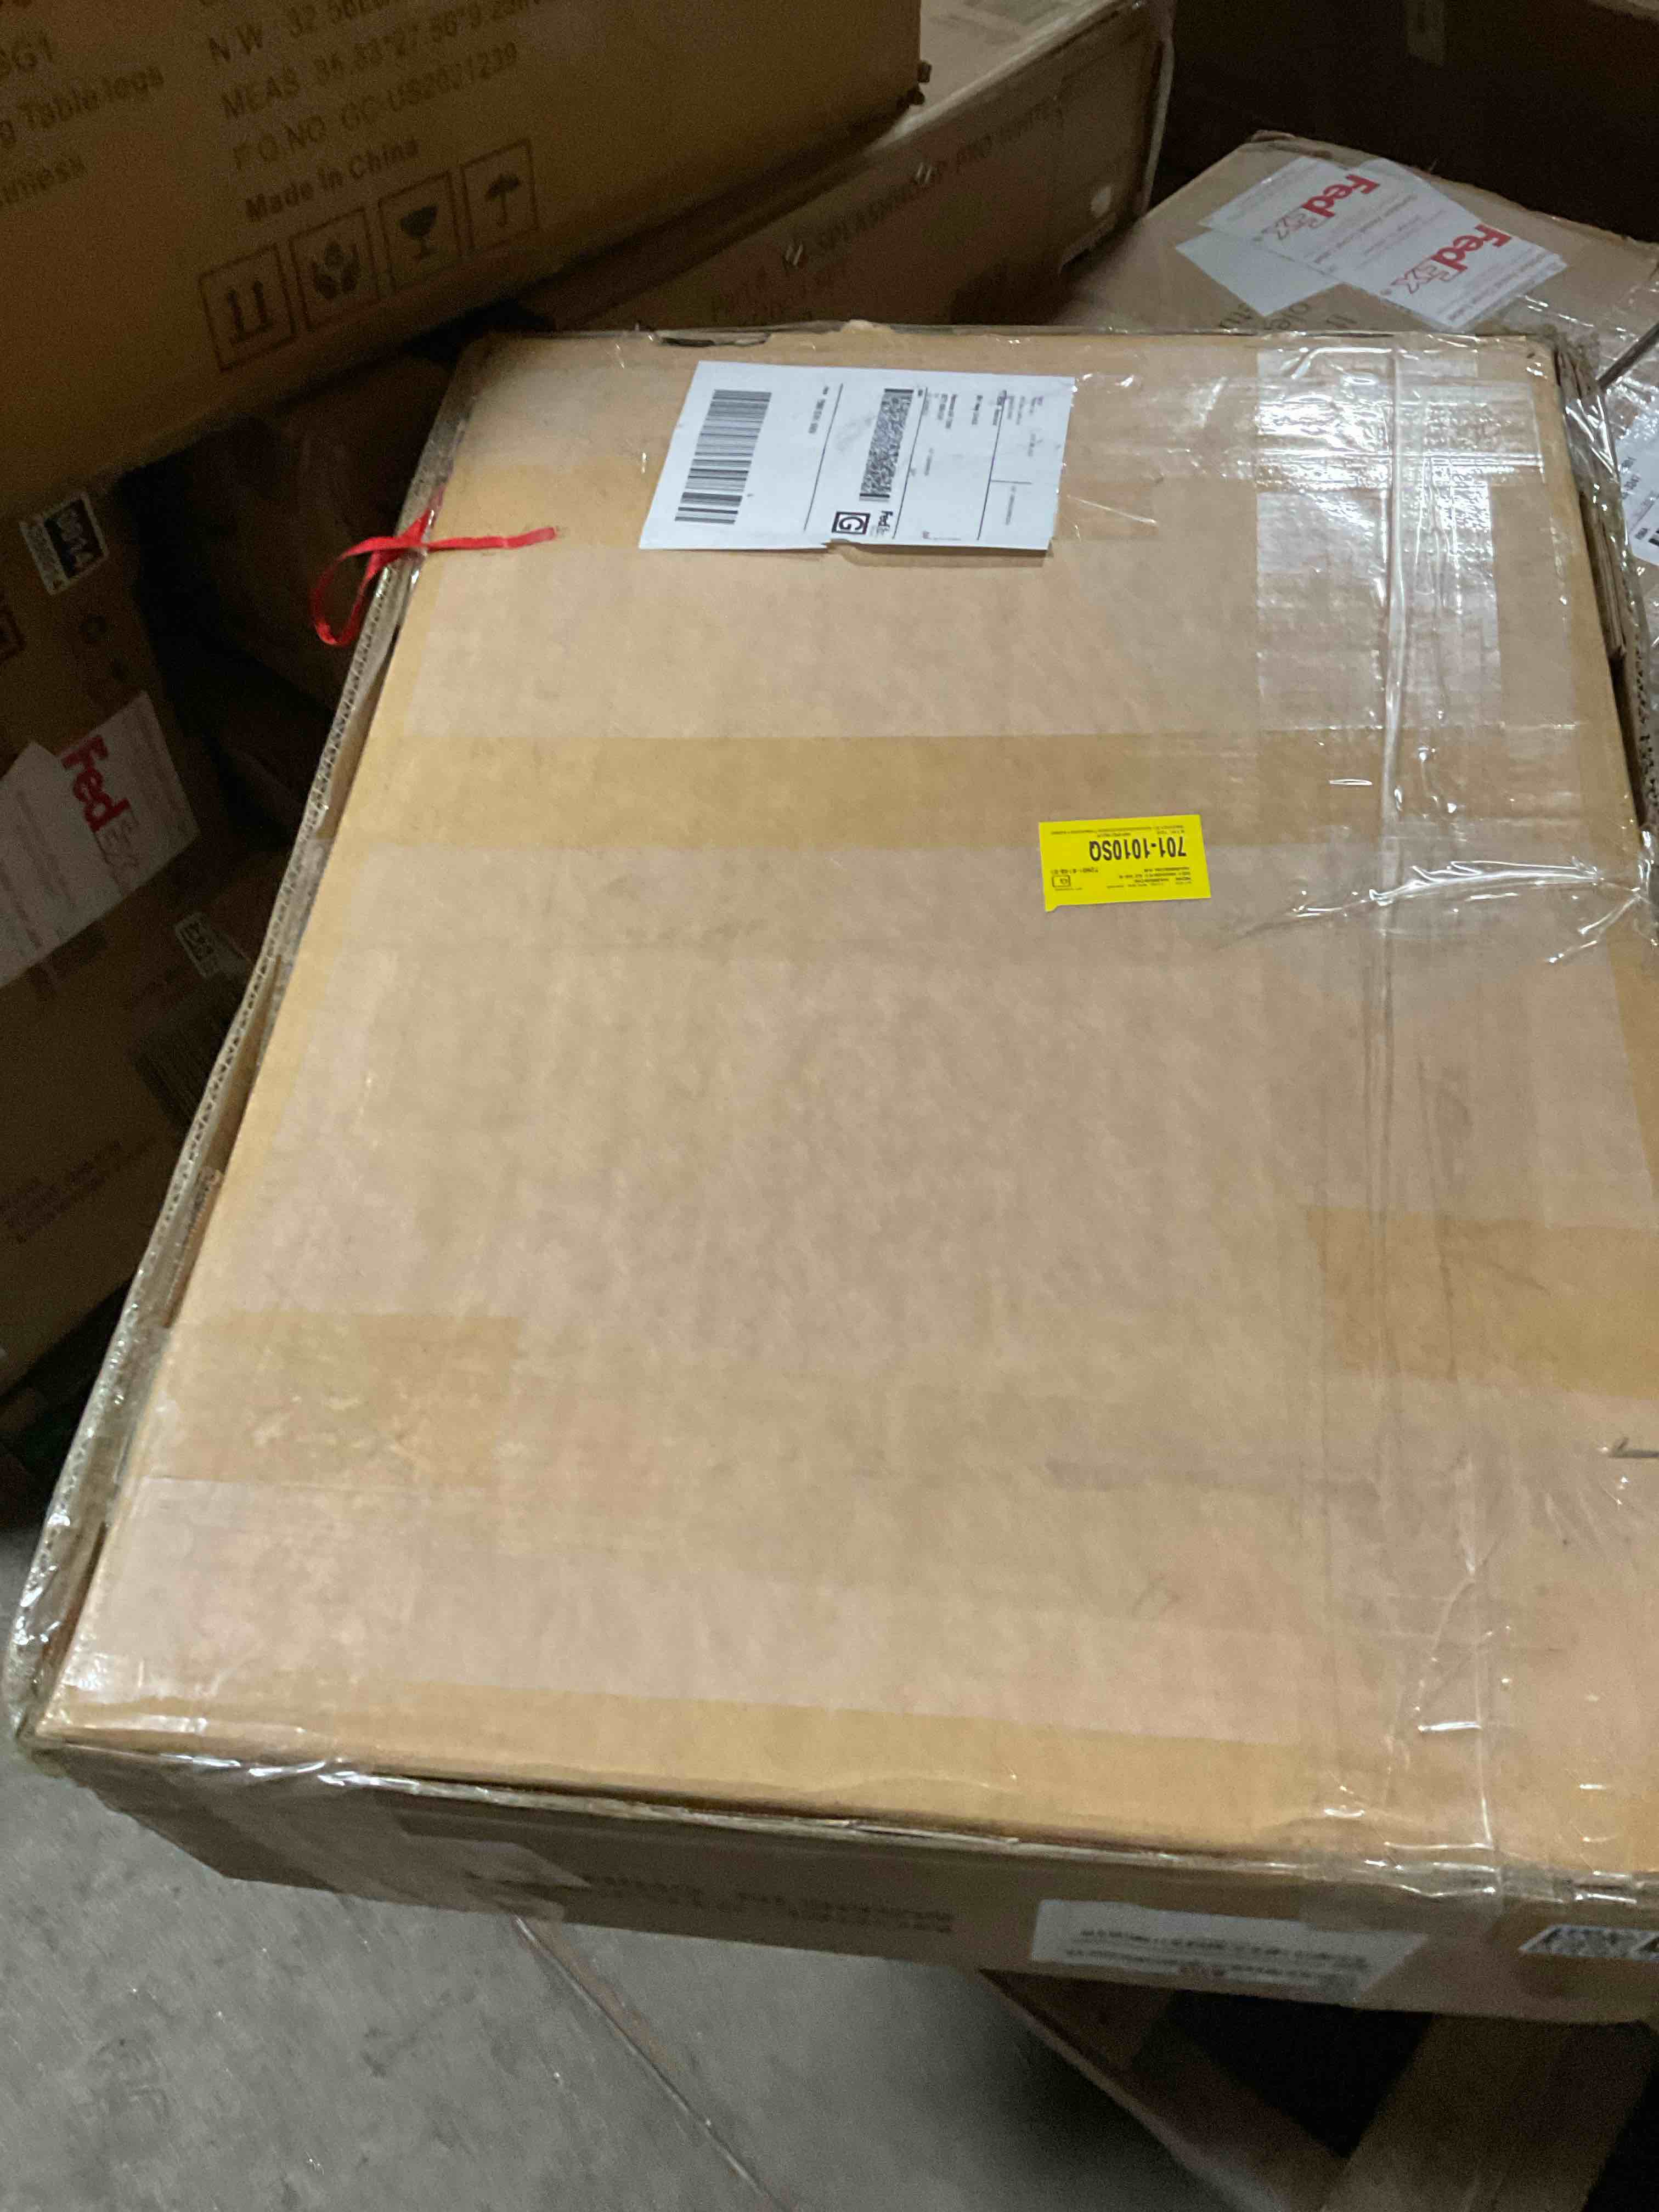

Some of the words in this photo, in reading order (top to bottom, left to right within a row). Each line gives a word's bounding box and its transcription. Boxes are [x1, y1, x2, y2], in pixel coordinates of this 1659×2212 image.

[245, 181, 314, 222] Made
[348, 138, 419, 180] China
[1391, 224, 1512, 294] FedEx
